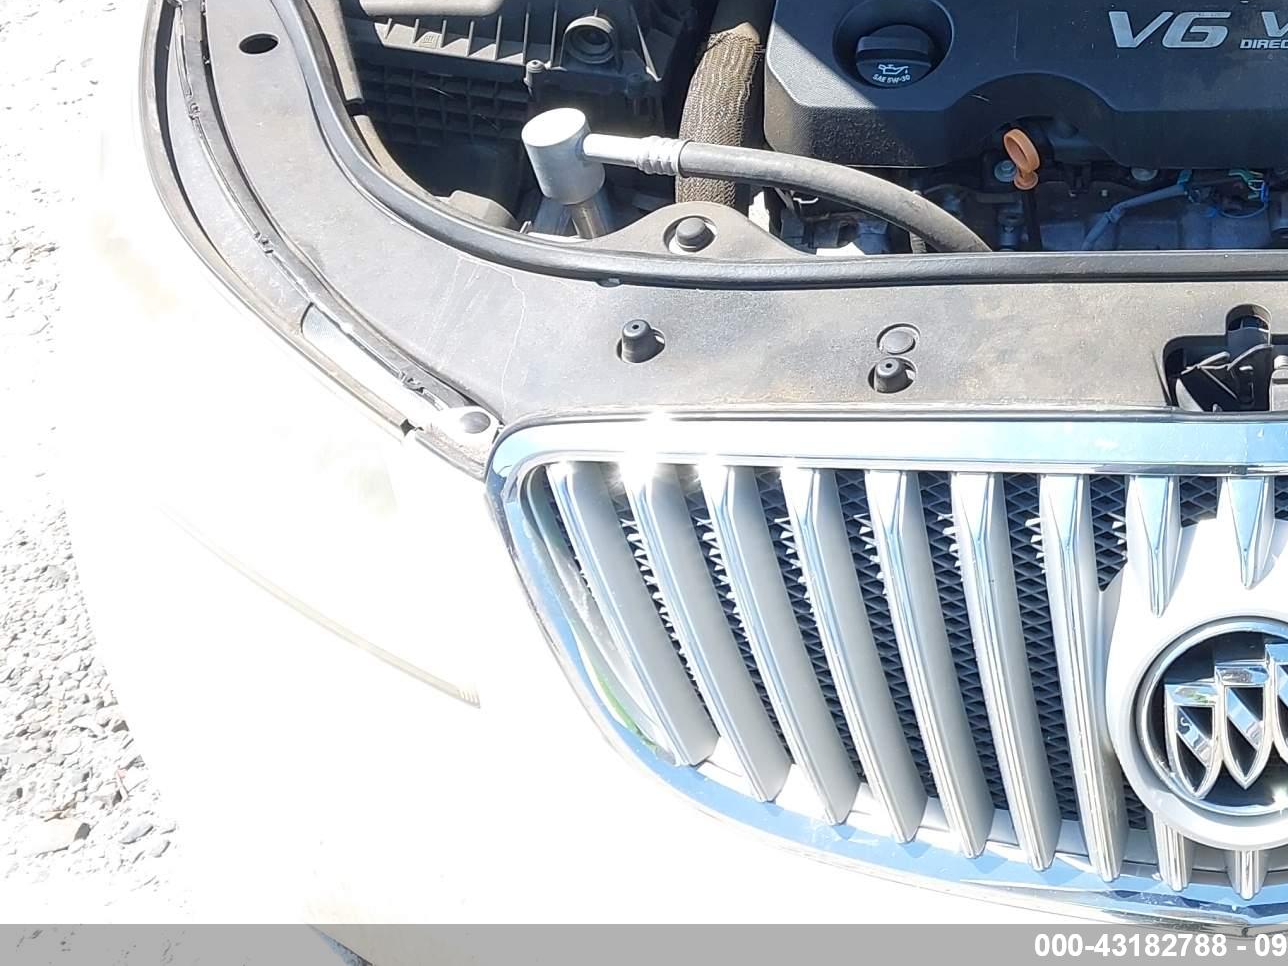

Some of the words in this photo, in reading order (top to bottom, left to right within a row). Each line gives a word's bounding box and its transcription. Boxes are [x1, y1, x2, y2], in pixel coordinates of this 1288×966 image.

[1108, 11, 1232, 48] V6
[872, 74, 886, 83] SAE
[886, 74, 911, 84] 5W-30
